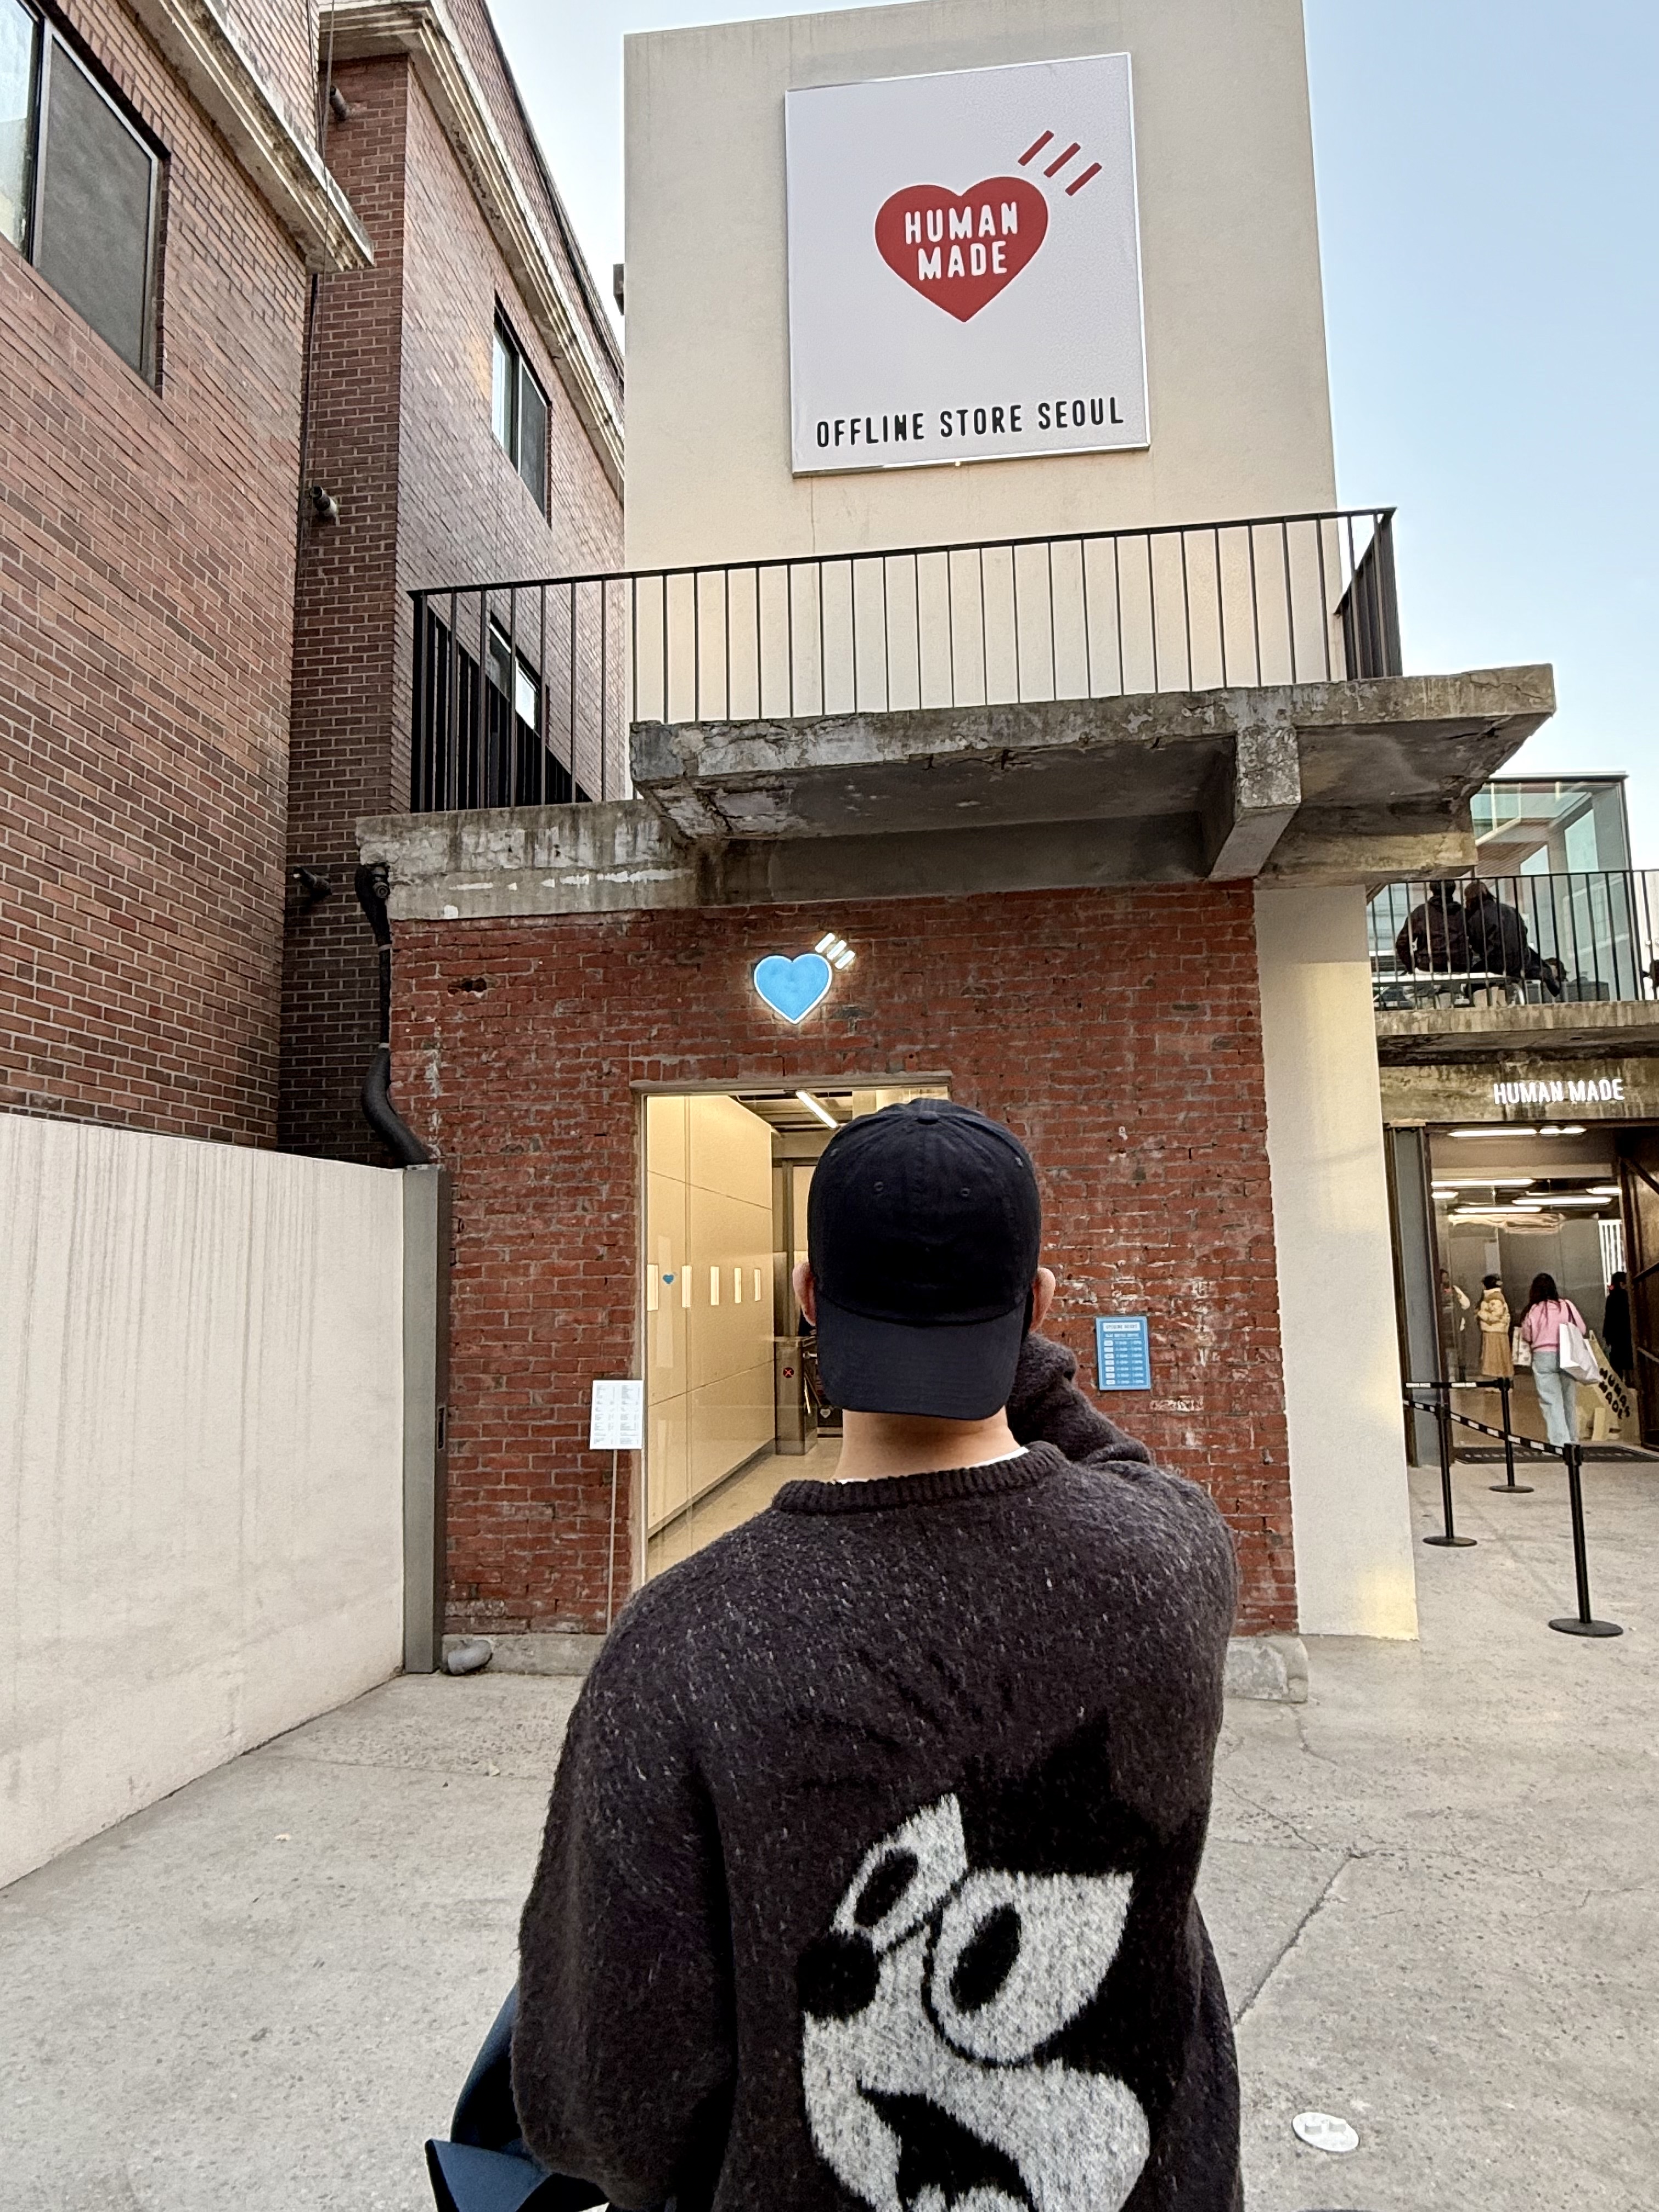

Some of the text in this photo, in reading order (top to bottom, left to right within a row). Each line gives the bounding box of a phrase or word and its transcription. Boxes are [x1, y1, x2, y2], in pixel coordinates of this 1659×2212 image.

[905, 201, 1018, 245] HUMAN
[918, 240, 1008, 281] MADE
[817, 397, 1124, 448] OFFLINE STORE SEOUL
[1493, 1079, 1626, 1104] HUMAN MADE
[1599, 1380, 1623, 1420] MADE
